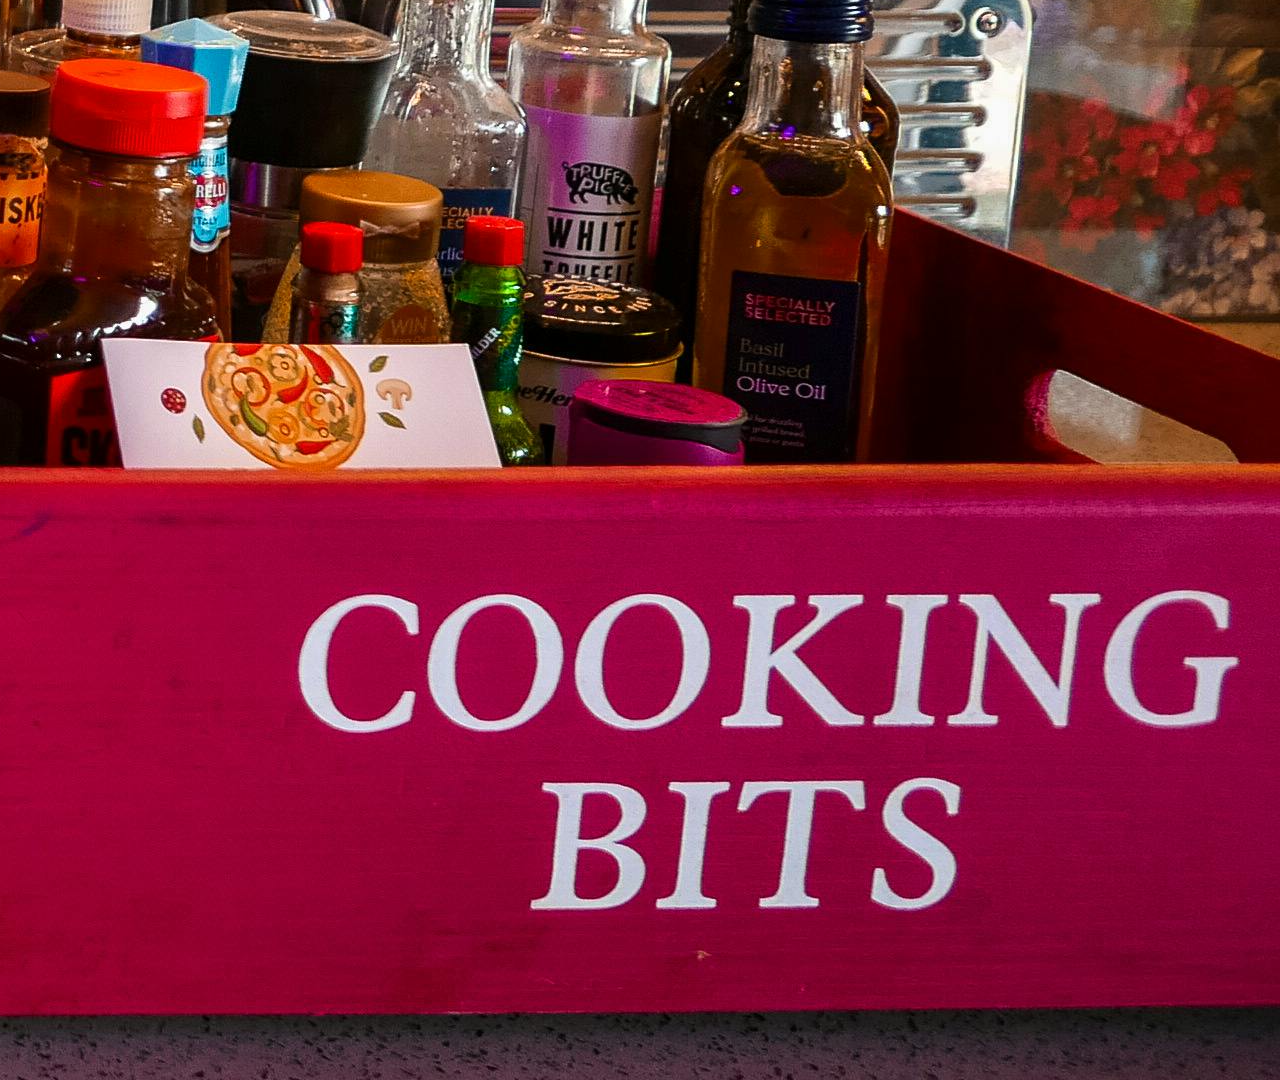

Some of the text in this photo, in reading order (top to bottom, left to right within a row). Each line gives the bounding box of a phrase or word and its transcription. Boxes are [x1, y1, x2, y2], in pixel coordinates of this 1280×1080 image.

[571, 165, 631, 192] TRUFFLE
[578, 179, 613, 194] PIG
[196, 181, 226, 198] RELLI
[442, 207, 494, 217] ECIALLY
[547, 216, 640, 252] WHITE
[437, 247, 464, 260] rlic
[544, 300, 623, 313] SINCE
[745, 293, 836, 313] SPECIALLY
[745, 307, 832, 326] SELECTED
[471, 327, 501, 358] ILDER
[740, 337, 784, 357] Basil
[739, 357, 811, 379] Infused
[736, 376, 827, 400] Olive Oil
[298, 590, 1239, 733] COOKING
[530, 777, 962, 911] BITS
